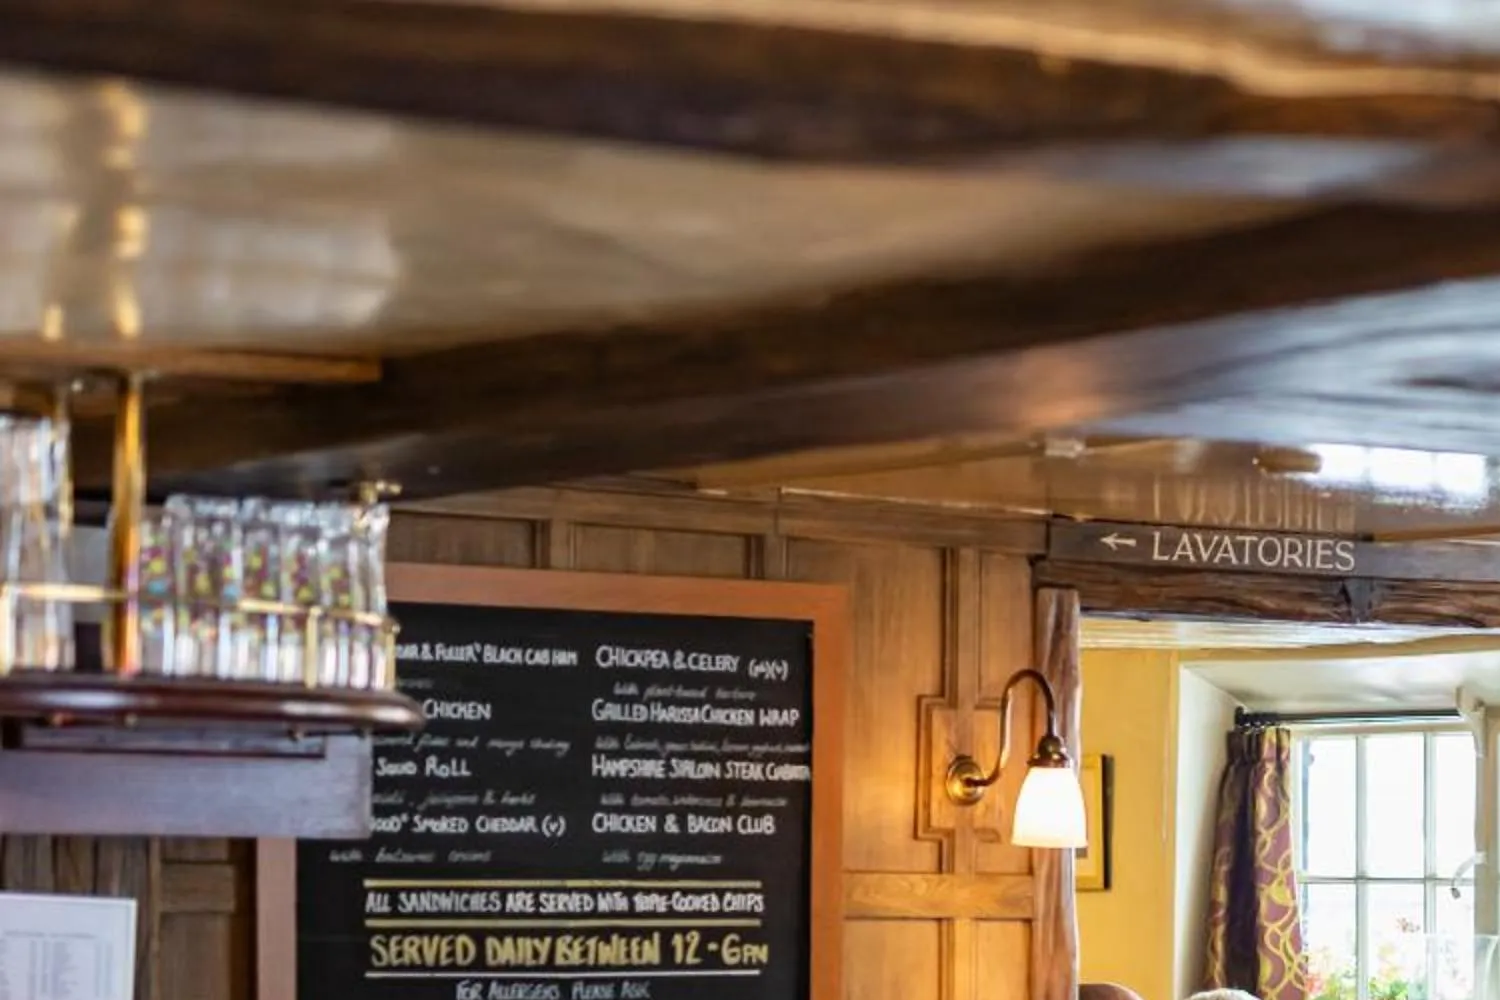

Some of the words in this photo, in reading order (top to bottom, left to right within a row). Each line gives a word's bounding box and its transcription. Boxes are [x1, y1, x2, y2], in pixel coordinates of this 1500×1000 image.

[1152, 531, 1355, 571] LAVATORIES
[483, 644, 523, 664] BLACK
[524, 647, 550, 665] CAB
[552, 649, 578, 666] HAM
[595, 645, 670, 669] CHICKPEA
[673, 649, 687, 670] &
[688, 652, 740, 673] CELERY
[422, 699, 492, 720] CHICKEN
[592, 698, 648, 722] GRILLED
[701, 704, 755, 726] CHICKEN
[759, 707, 799, 727] WRAP
[425, 754, 472, 778] ROLL
[725, 760, 765, 781] STEAK
[411, 815, 469, 833] SMOKED
[475, 815, 538, 833] CHEDDAR
[592, 813, 657, 833] CHICKEN
[664, 813, 680, 833] &
[687, 814, 733, 834] BACON
[737, 815, 776, 834] CLUB
[365, 891, 391, 913] ALL
[398, 891, 501, 913] SANDWICHES
[505, 892, 535, 913] ARE
[539, 891, 594, 913] SERVED
[597, 891, 628, 913] WITH
[722, 892, 764, 913] CHIPS
[370, 934, 476, 967] SERVED
[485, 935, 551, 967] DAILY
[554, 931, 661, 966] BETWEEN
[571, 981, 617, 1000] PLEASE
[620, 981, 651, 1000] ASK
